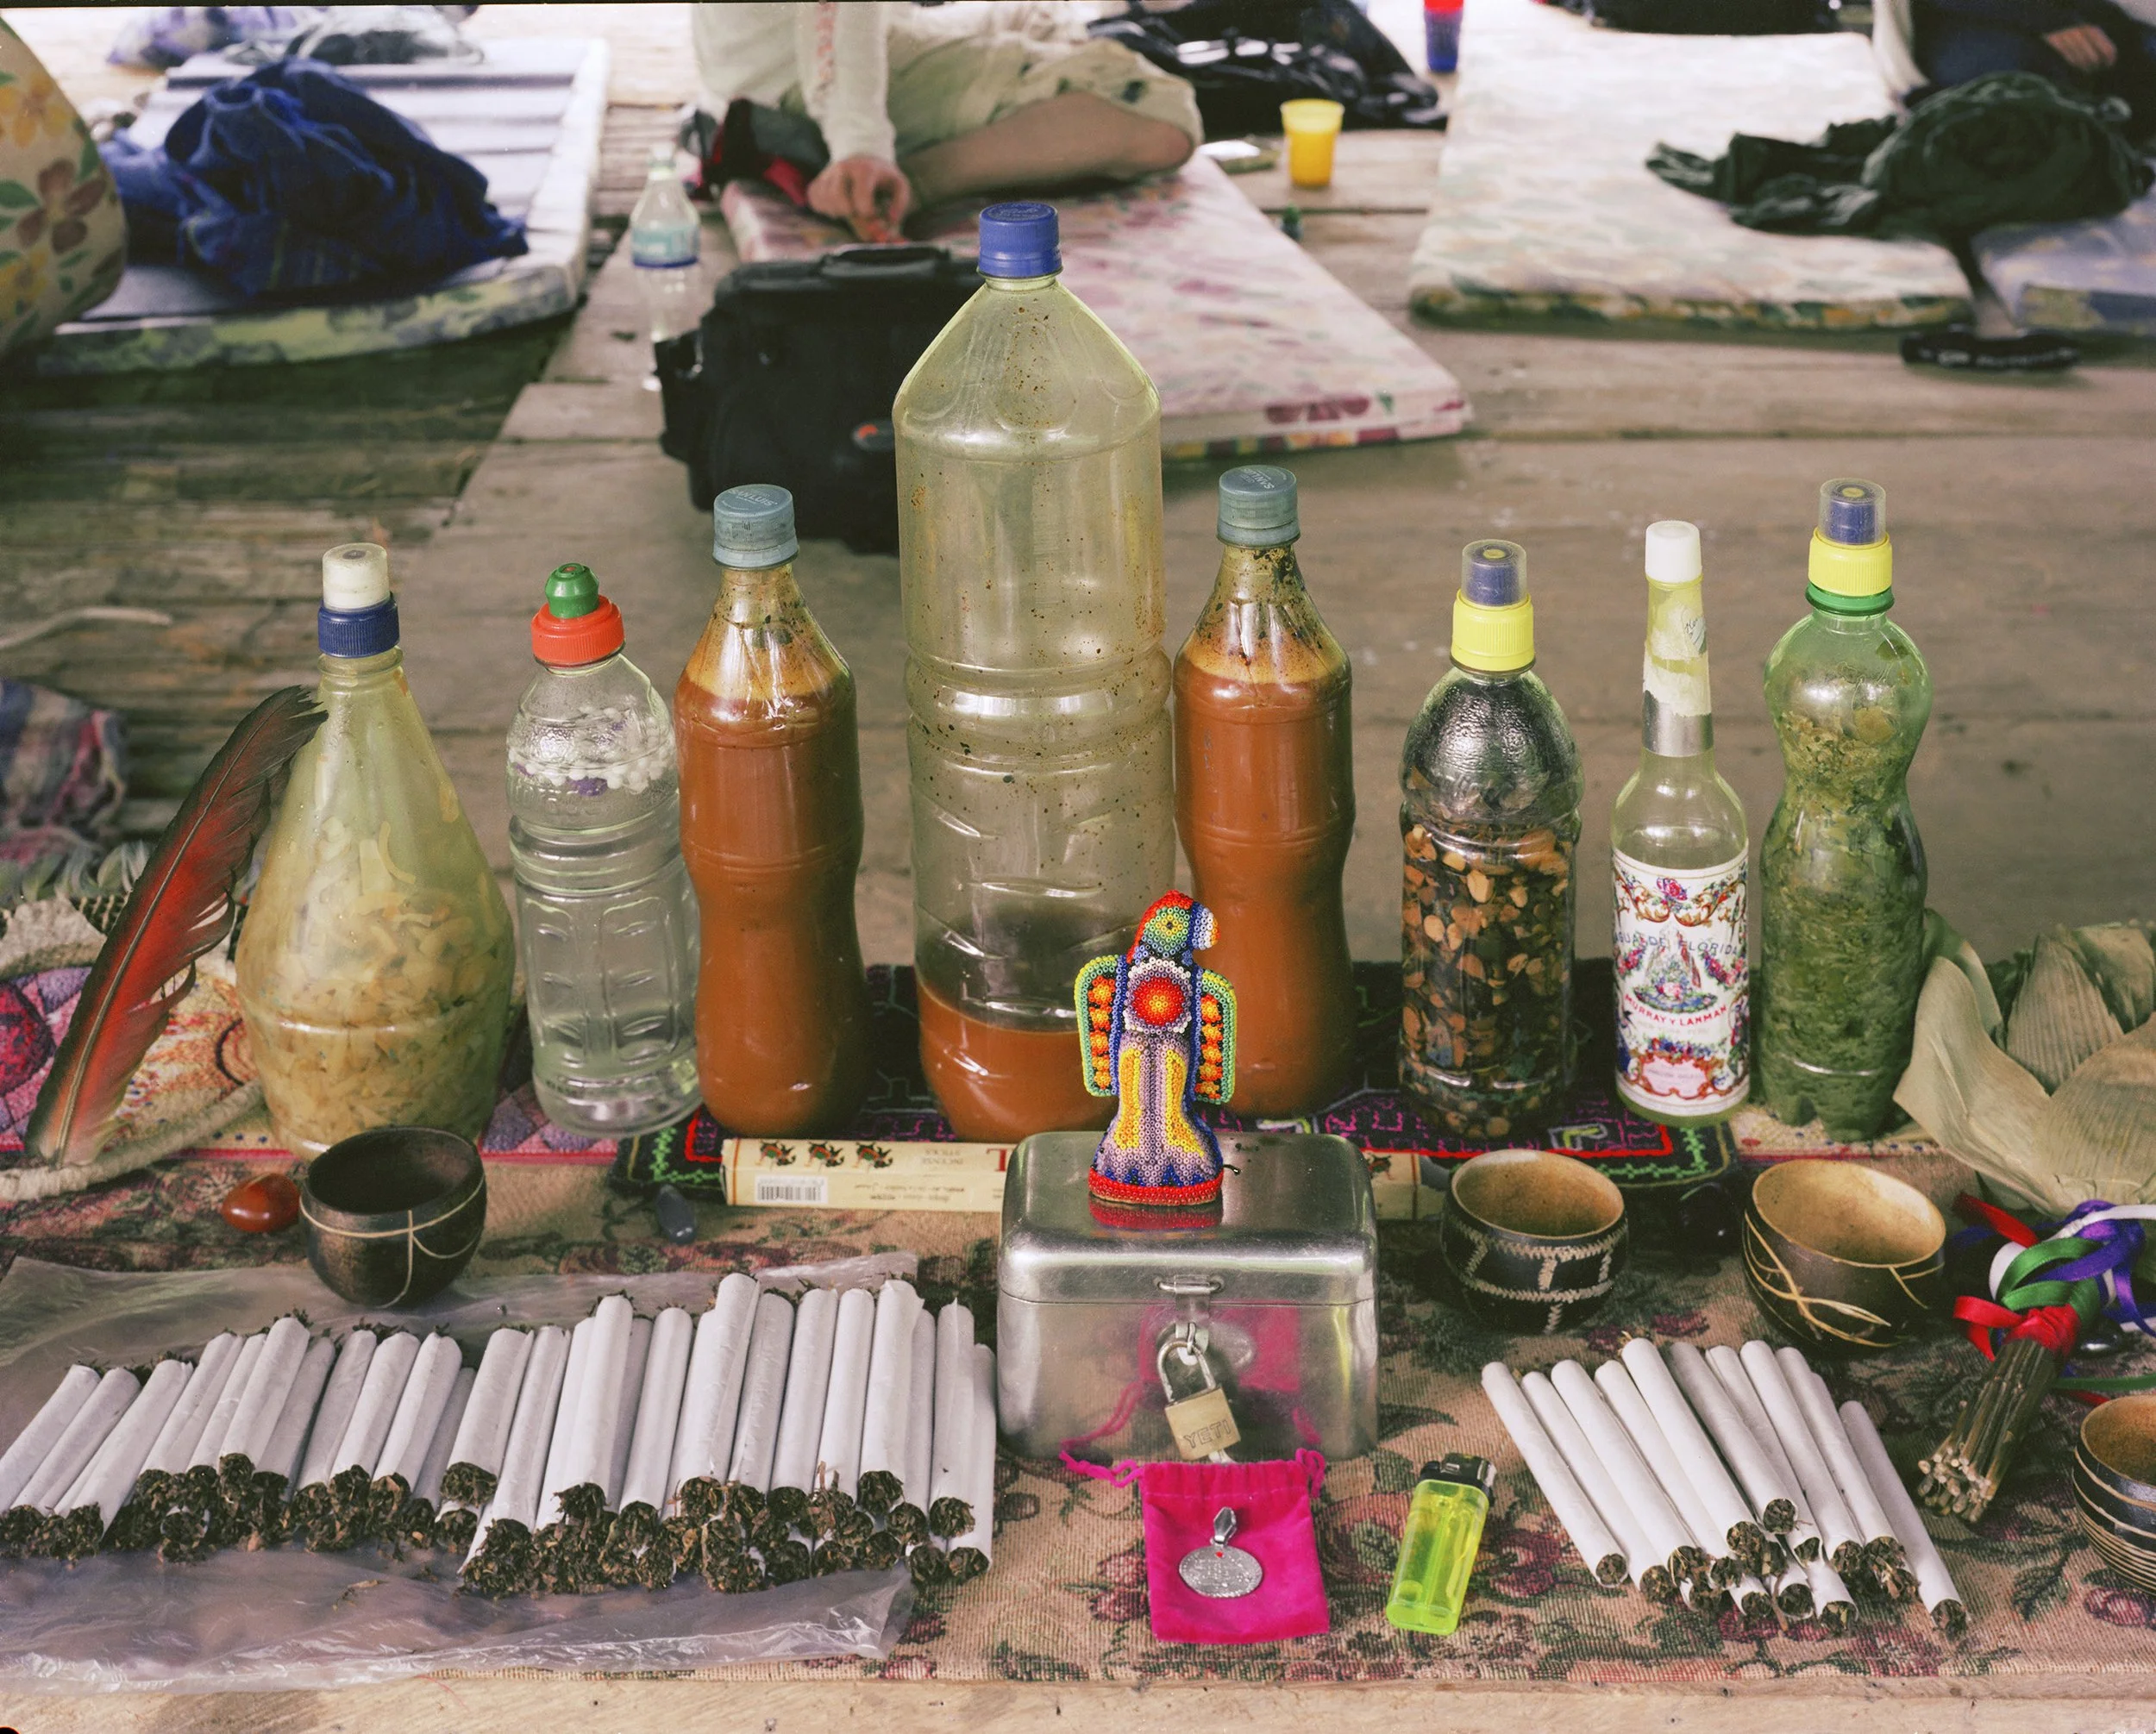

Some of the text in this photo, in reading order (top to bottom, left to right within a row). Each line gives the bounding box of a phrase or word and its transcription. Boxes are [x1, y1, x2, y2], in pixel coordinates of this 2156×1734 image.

[1648, 936, 1666, 948] DE
[1678, 940, 1738, 955] FLORIDA
[1625, 994, 1666, 1023] MURRAY
[1680, 1005, 1727, 1026] LANMAN
[1183, 1419, 1231, 1449] YETI
